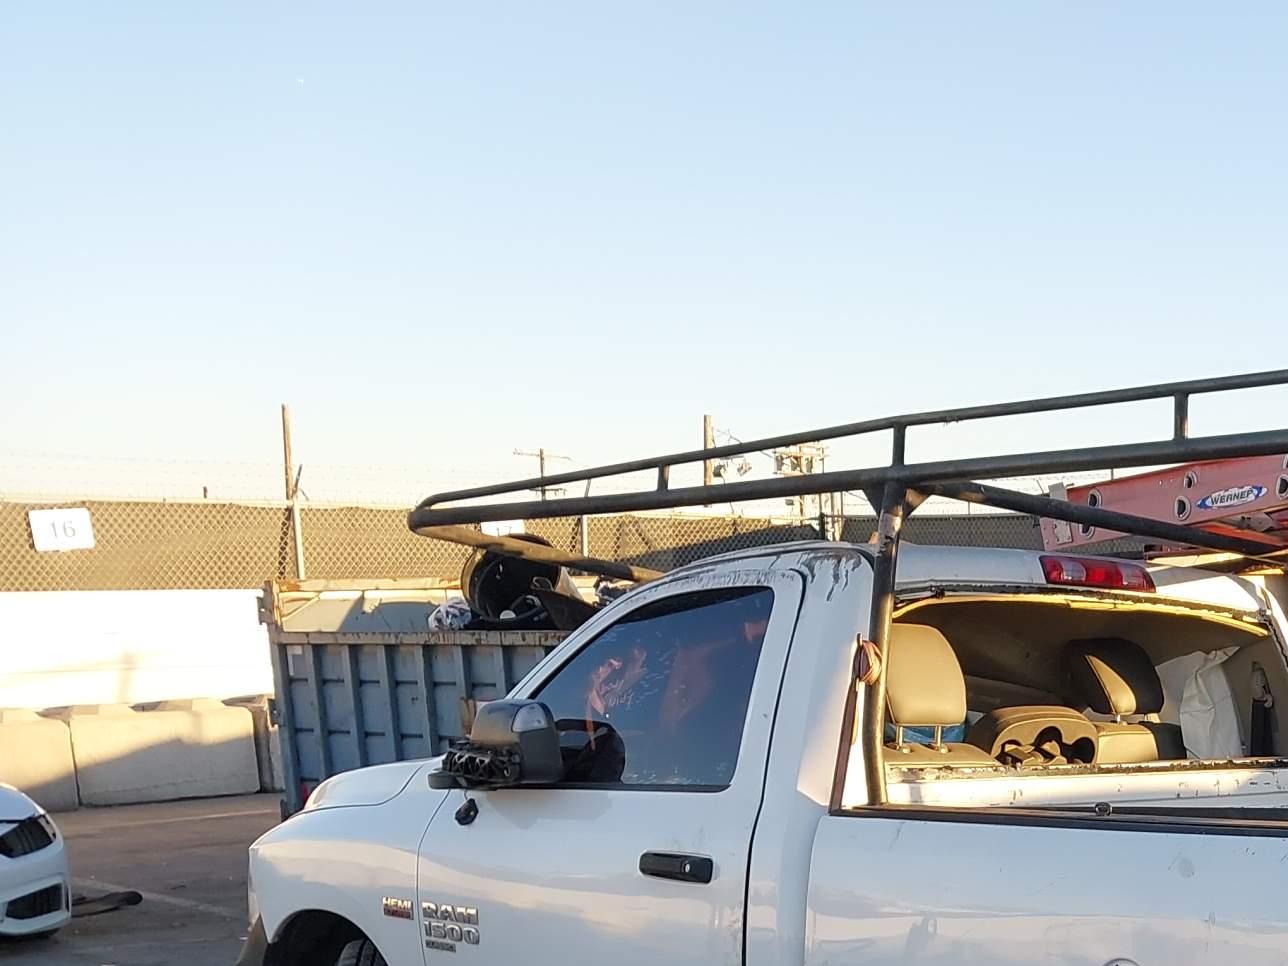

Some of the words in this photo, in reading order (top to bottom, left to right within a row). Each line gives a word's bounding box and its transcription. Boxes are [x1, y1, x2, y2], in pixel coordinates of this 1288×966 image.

[51, 520, 76, 538] 16
[382, 896, 413, 910] HEMI
[421, 901, 478, 925] RAM
[423, 920, 480, 945] 1500
